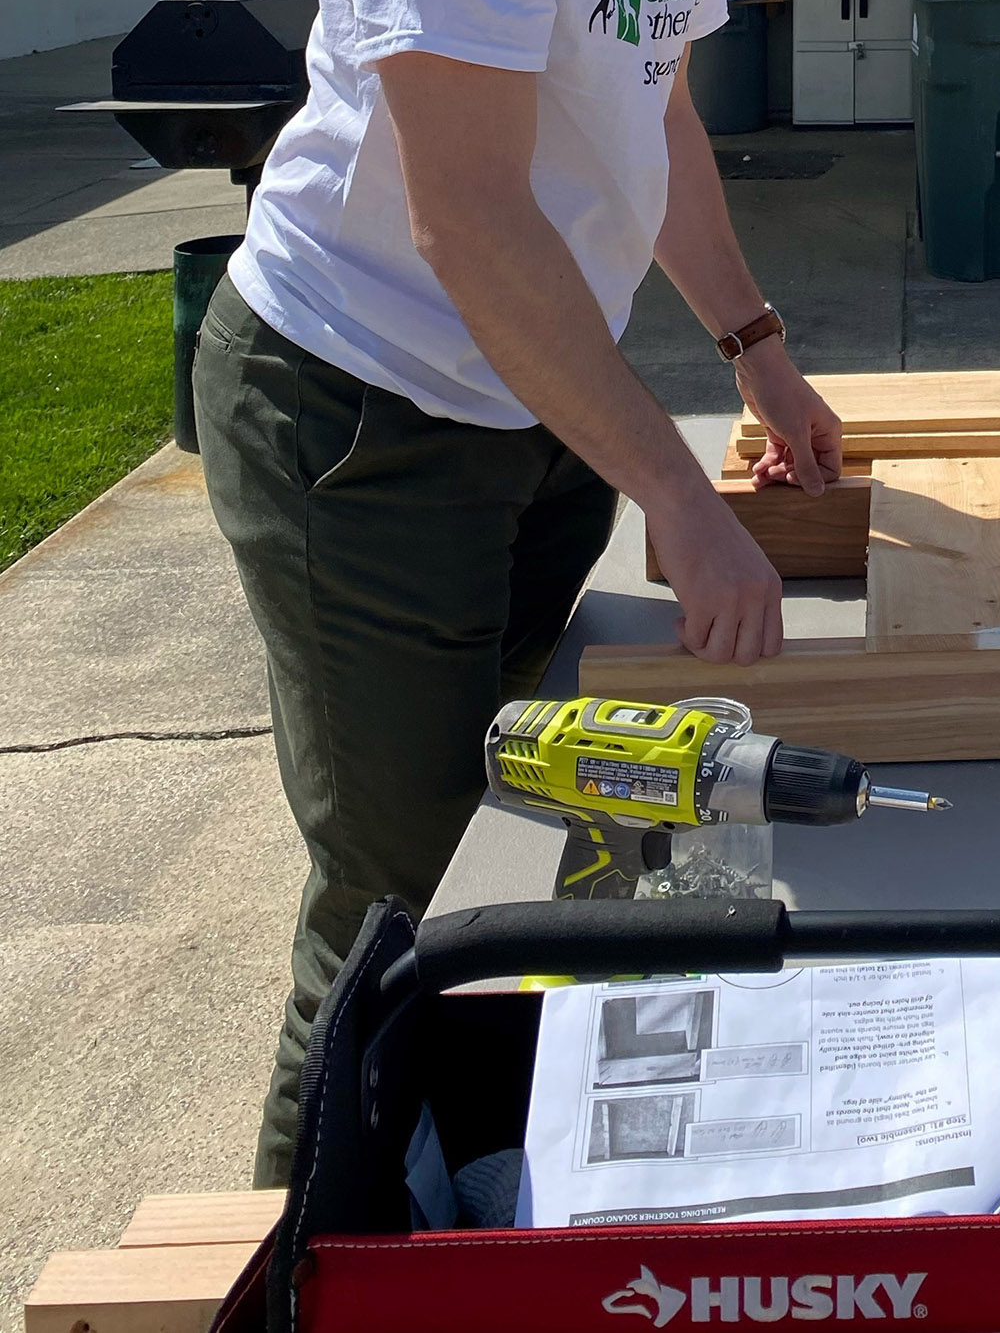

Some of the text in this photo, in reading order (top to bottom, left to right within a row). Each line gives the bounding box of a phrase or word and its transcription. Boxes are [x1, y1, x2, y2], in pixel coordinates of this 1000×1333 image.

[702, 762, 714, 778] 16
[700, 809, 712, 822] 20
[862, 999, 883, 1008] facing
[891, 998, 909, 1007] holes
[911, 996, 924, 1005] drill
[896, 1004, 933, 1013] Remember
[879, 1050, 897, 1058] paint
[876, 1105, 891, 1113] that
[893, 1102, 910, 1110] Note
[836, 1108, 861, 1116] boards
[837, 1117, 861, 1125] ground
[856, 1115, 966, 1145] Step #1: (assemble two)
[915, 1130, 972, 1146] Instructions:
[573, 1206, 726, 1226] REBUILDING TOGETHER SOLANO COUNTY
[691, 1272, 928, 1322] HUSKY
